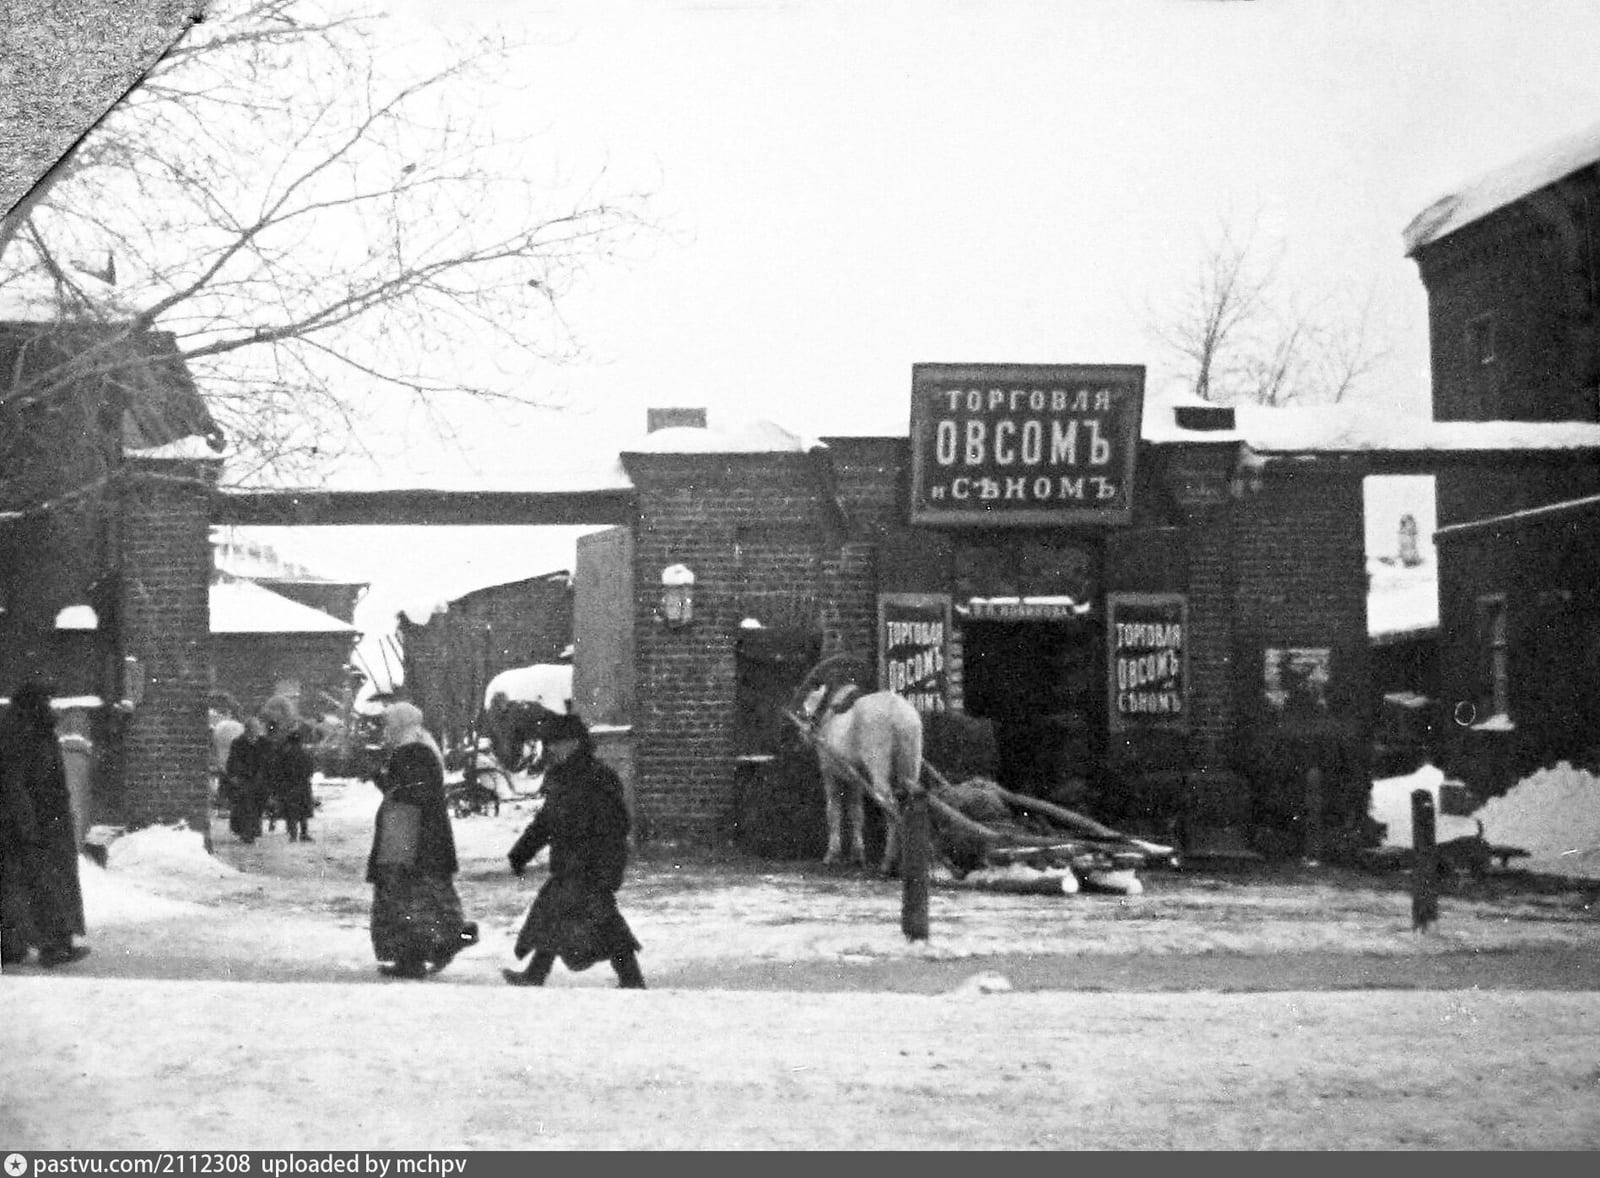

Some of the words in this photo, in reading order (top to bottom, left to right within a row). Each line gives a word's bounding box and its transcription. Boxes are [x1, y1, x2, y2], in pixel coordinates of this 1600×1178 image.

[947, 389, 1110, 412] ТОРГОВЛЯ
[936, 419, 1111, 465] ОВСОМЪ
[951, 476, 1116, 499] СѢНОМЪ
[886, 621, 943, 648] ТОРГОВЛЯ
[1115, 623, 1180, 647] ТОРГОВЛЯ
[888, 646, 943, 692] ОВСОМЪ
[1118, 649, 1179, 690] ОВСОМЪ
